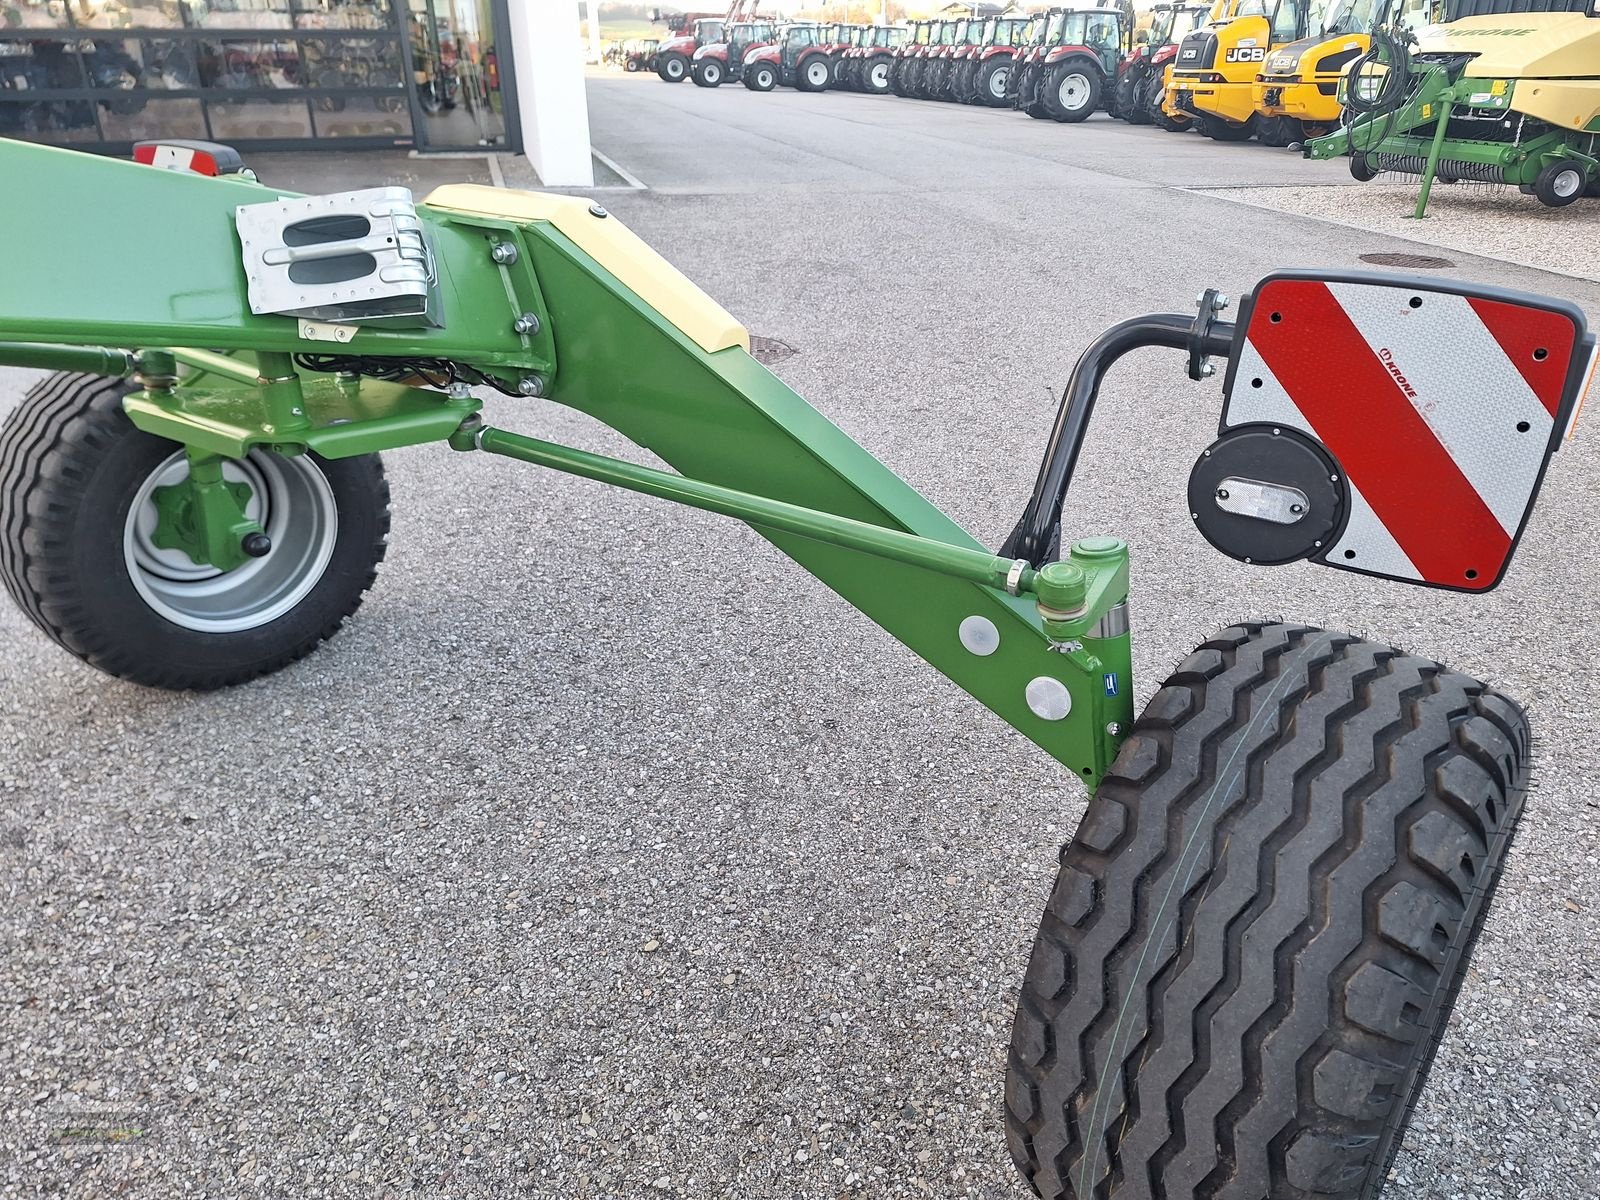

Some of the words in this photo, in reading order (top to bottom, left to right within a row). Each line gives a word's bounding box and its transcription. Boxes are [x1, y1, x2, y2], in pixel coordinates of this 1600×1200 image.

[1182, 49, 1197, 59] JCB
[1226, 48, 1265, 62] JCB
[1273, 57, 1290, 66] JCB
[1386, 361, 1418, 398] KRONE
